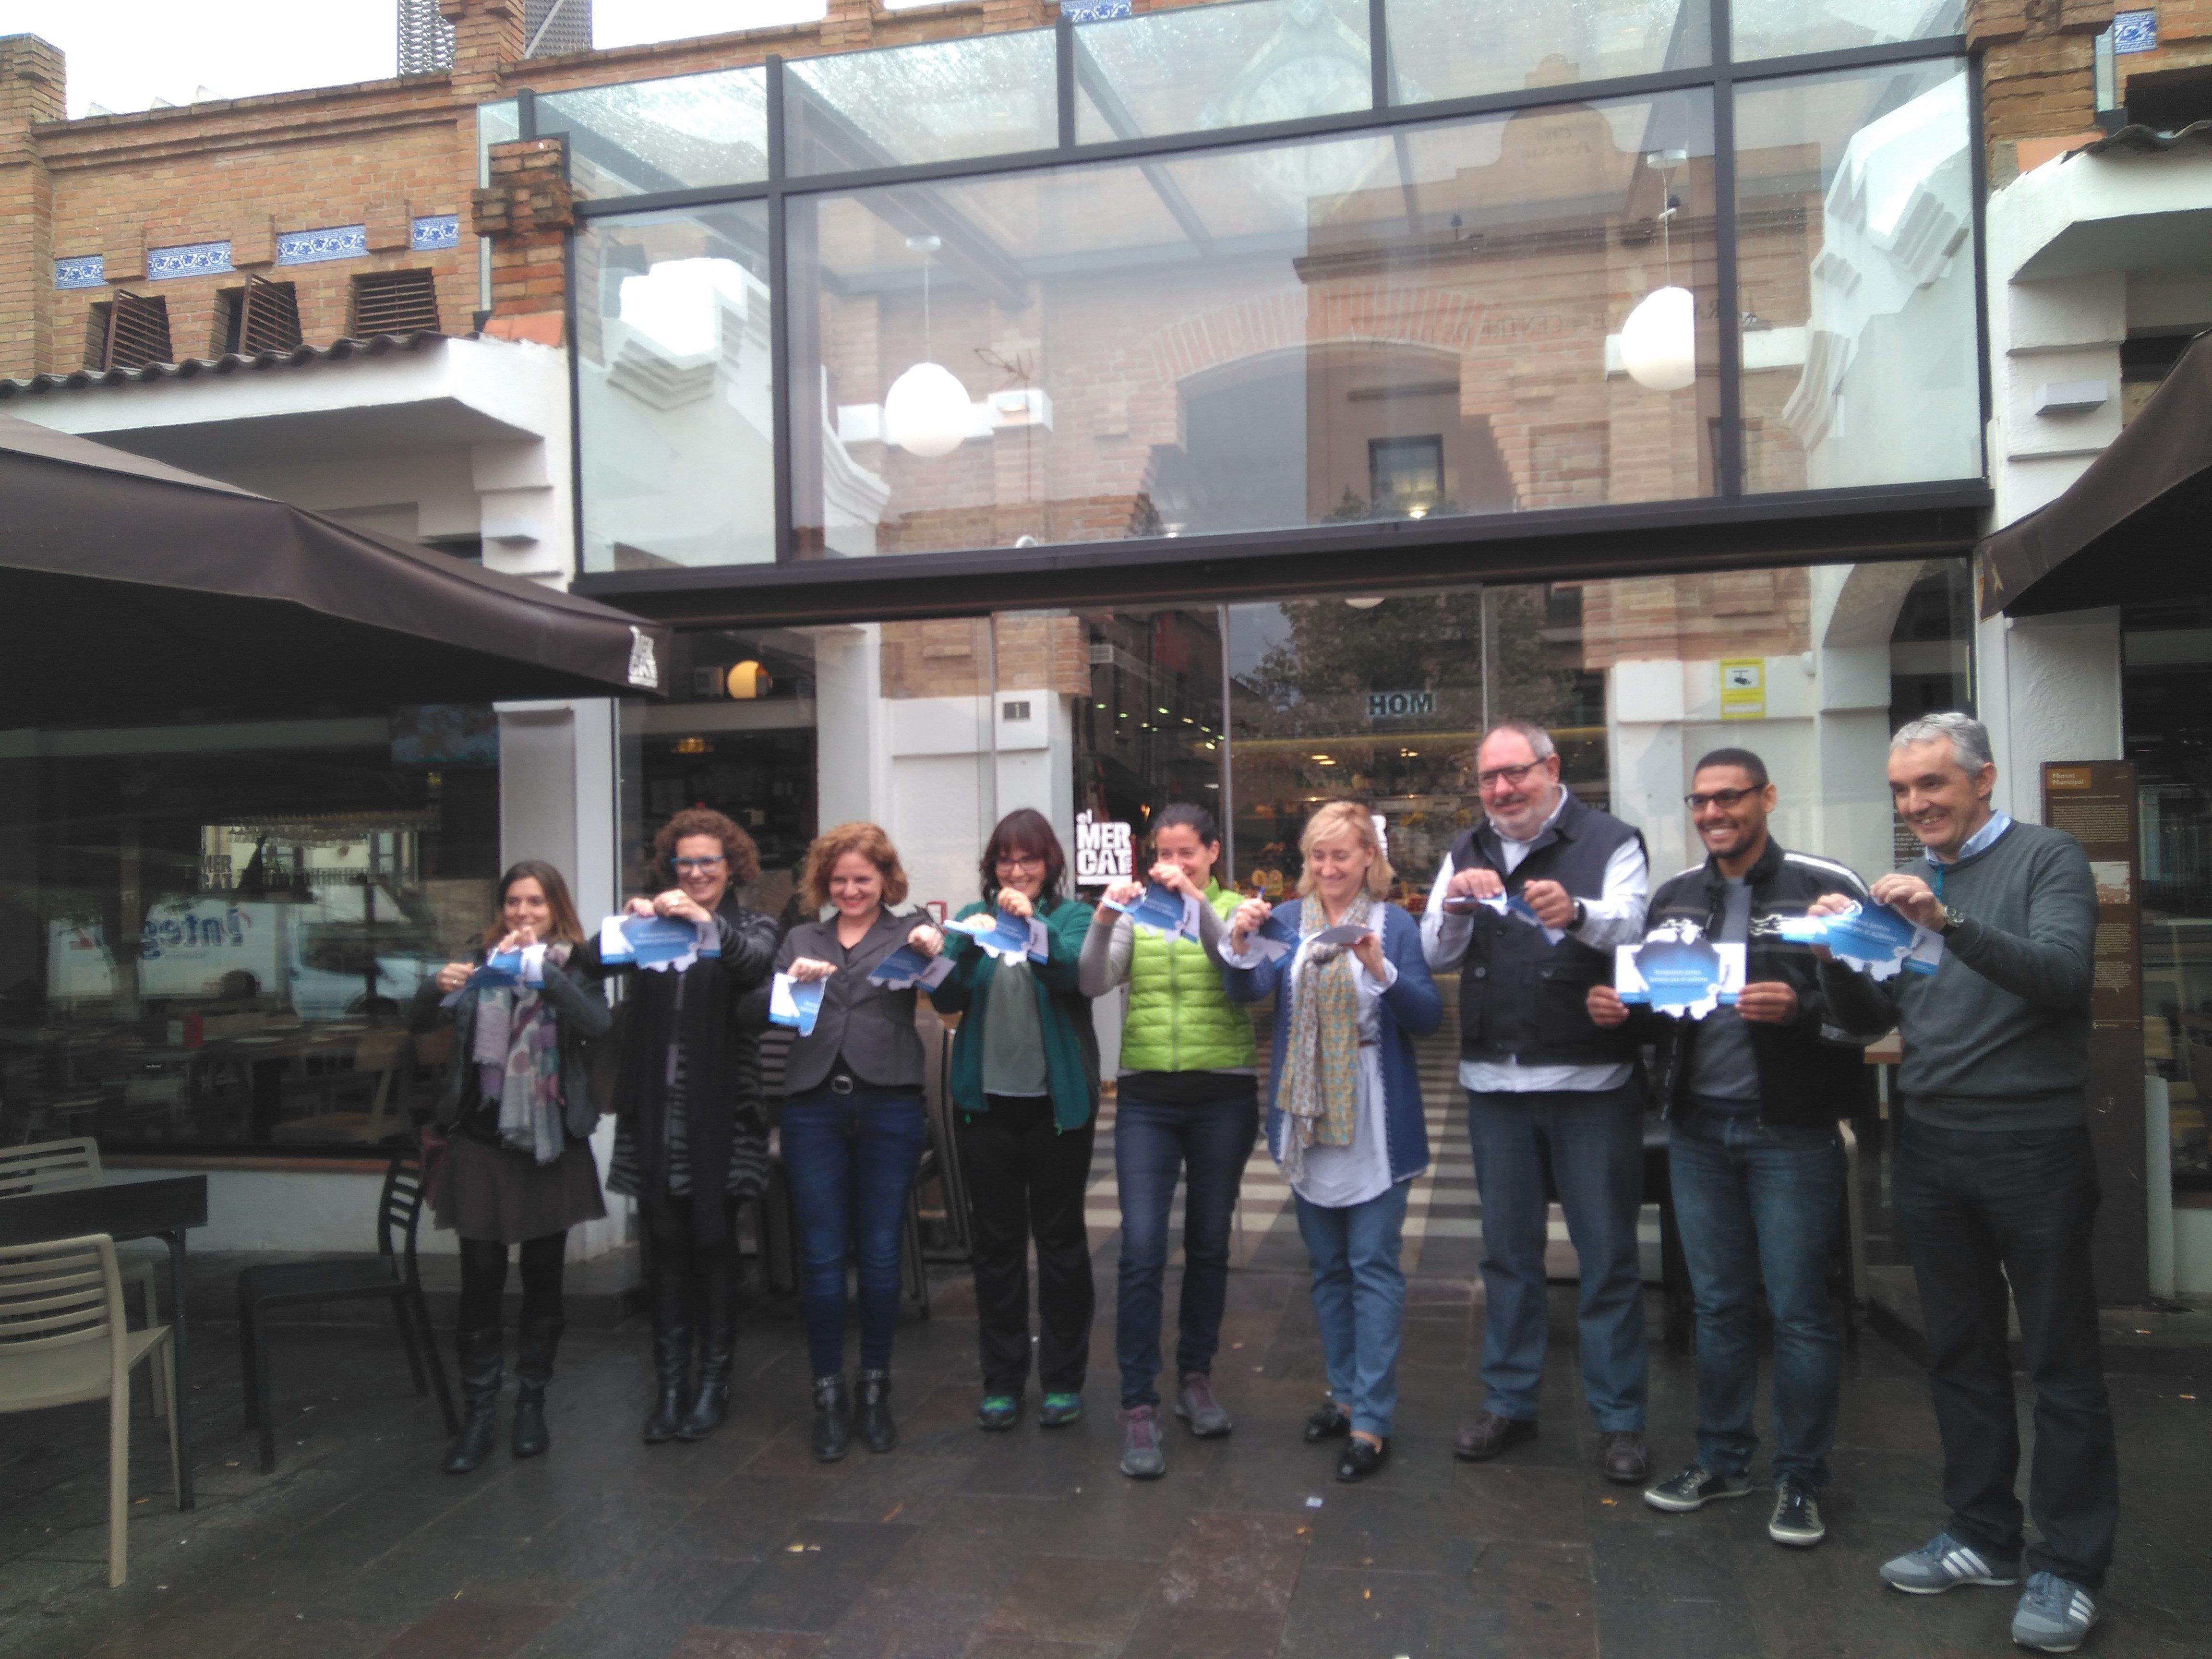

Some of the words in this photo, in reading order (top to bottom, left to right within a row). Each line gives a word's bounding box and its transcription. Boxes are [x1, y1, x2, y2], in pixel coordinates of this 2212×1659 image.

[1370, 694, 1432, 715] HOM
[1076, 808, 1092, 824] el
[1077, 822, 1132, 850] MER
[1077, 849, 1132, 876] CAT
